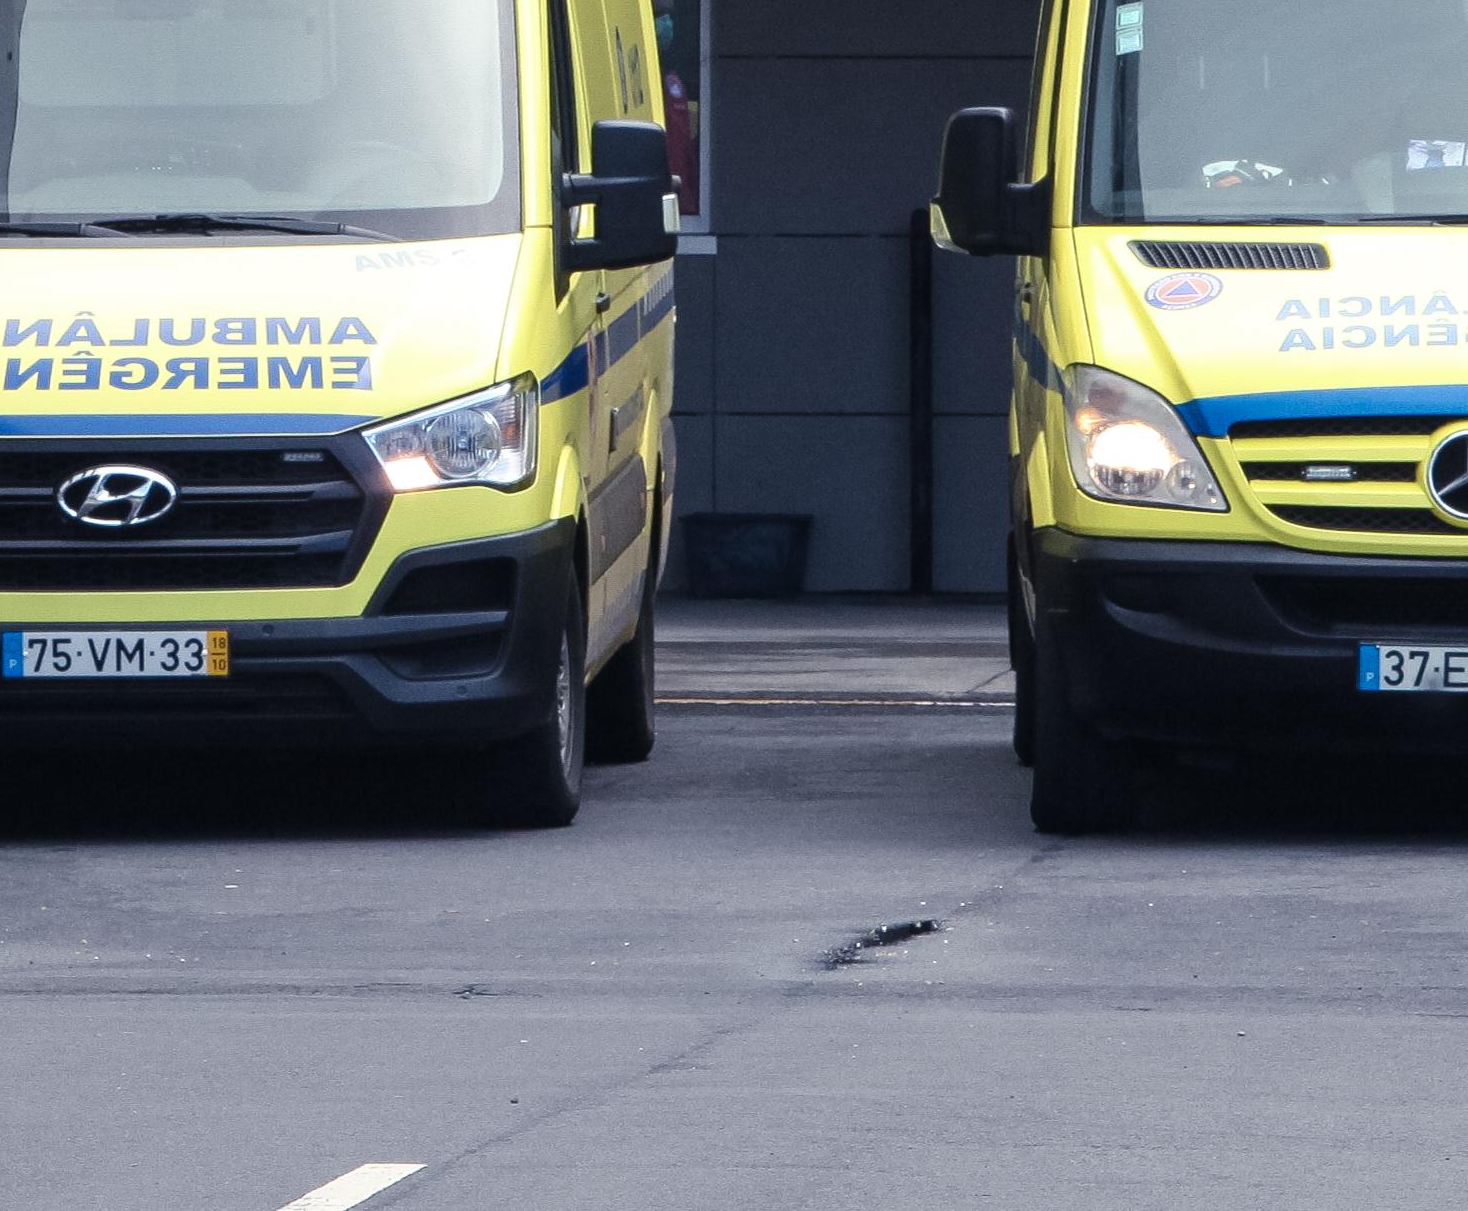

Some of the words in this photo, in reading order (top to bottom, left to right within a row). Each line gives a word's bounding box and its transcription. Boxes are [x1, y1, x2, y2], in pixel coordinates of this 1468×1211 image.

[212, 637, 226, 650] 18
[9, 659, 18, 669] P
[212, 658, 226, 671] 10
